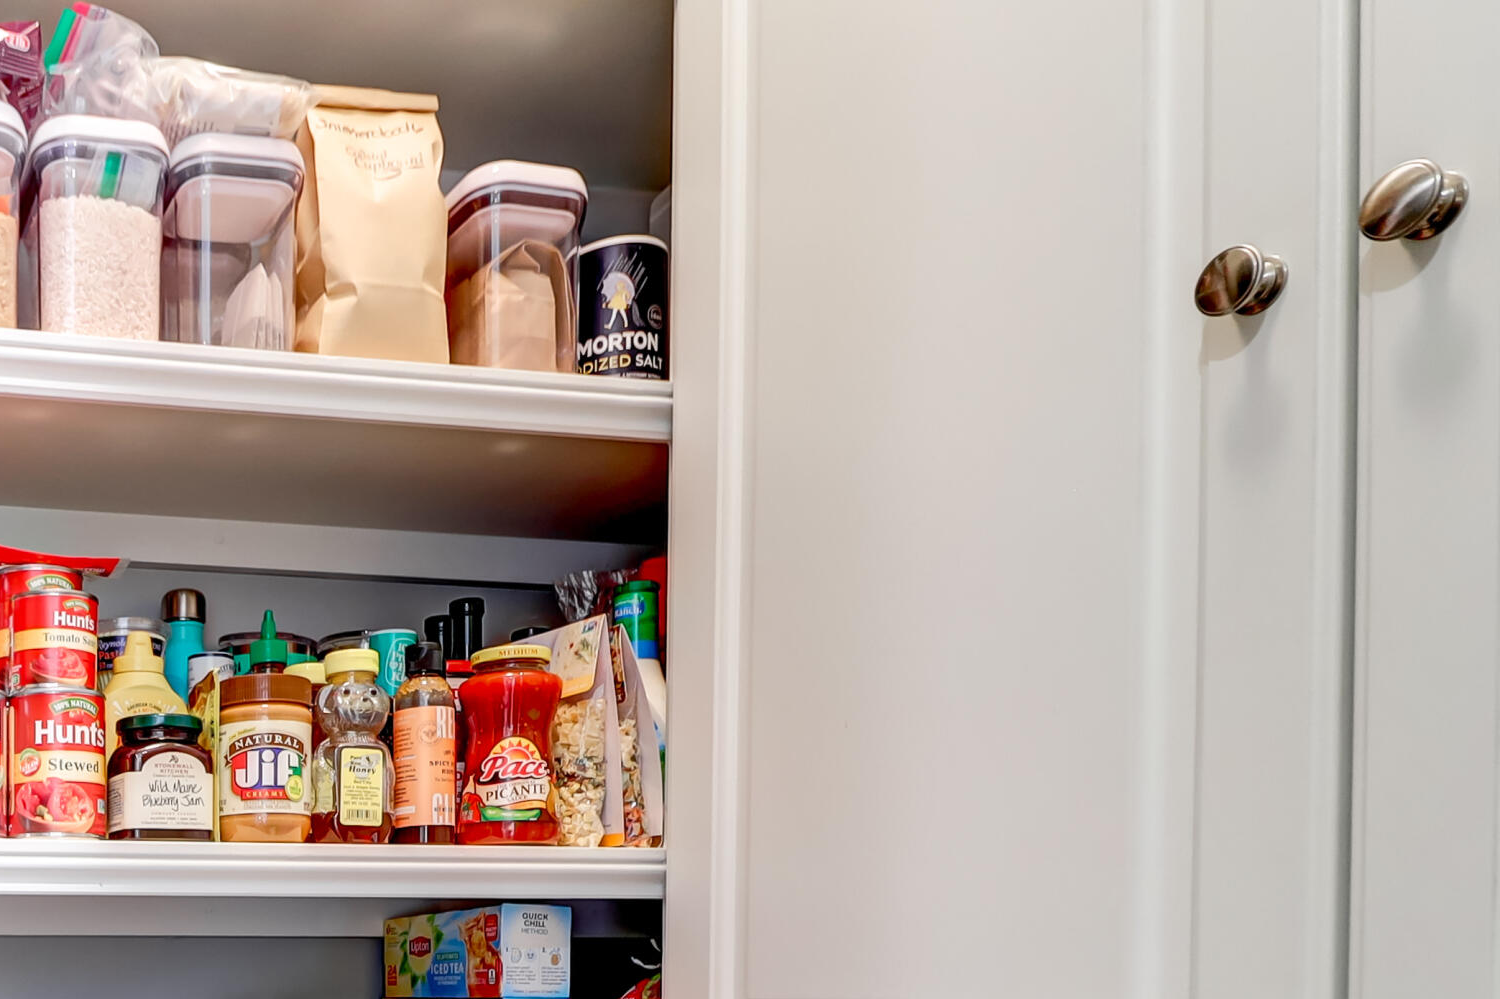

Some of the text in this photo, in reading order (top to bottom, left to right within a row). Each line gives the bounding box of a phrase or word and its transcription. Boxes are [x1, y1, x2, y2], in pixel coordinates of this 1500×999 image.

[577, 331, 658, 360] MORTON
[54, 611, 94, 630] Hunt's
[499, 648, 538, 657] MEDIUM
[34, 720, 104, 746] Hunt's
[235, 735, 300, 750] NATURAL
[48, 758, 99, 773] Stewed
[235, 750, 299, 788] Jif
[349, 765, 376, 775] Honey
[482, 756, 549, 782] Pace
[246, 790, 283, 798] CREAMY
[486, 783, 547, 801] PICANTE
[522, 913, 548, 921] QUICK
[524, 920, 546, 928] CHILL
[521, 928, 548, 936] METHOD
[431, 964, 465, 973] ICED TEA
